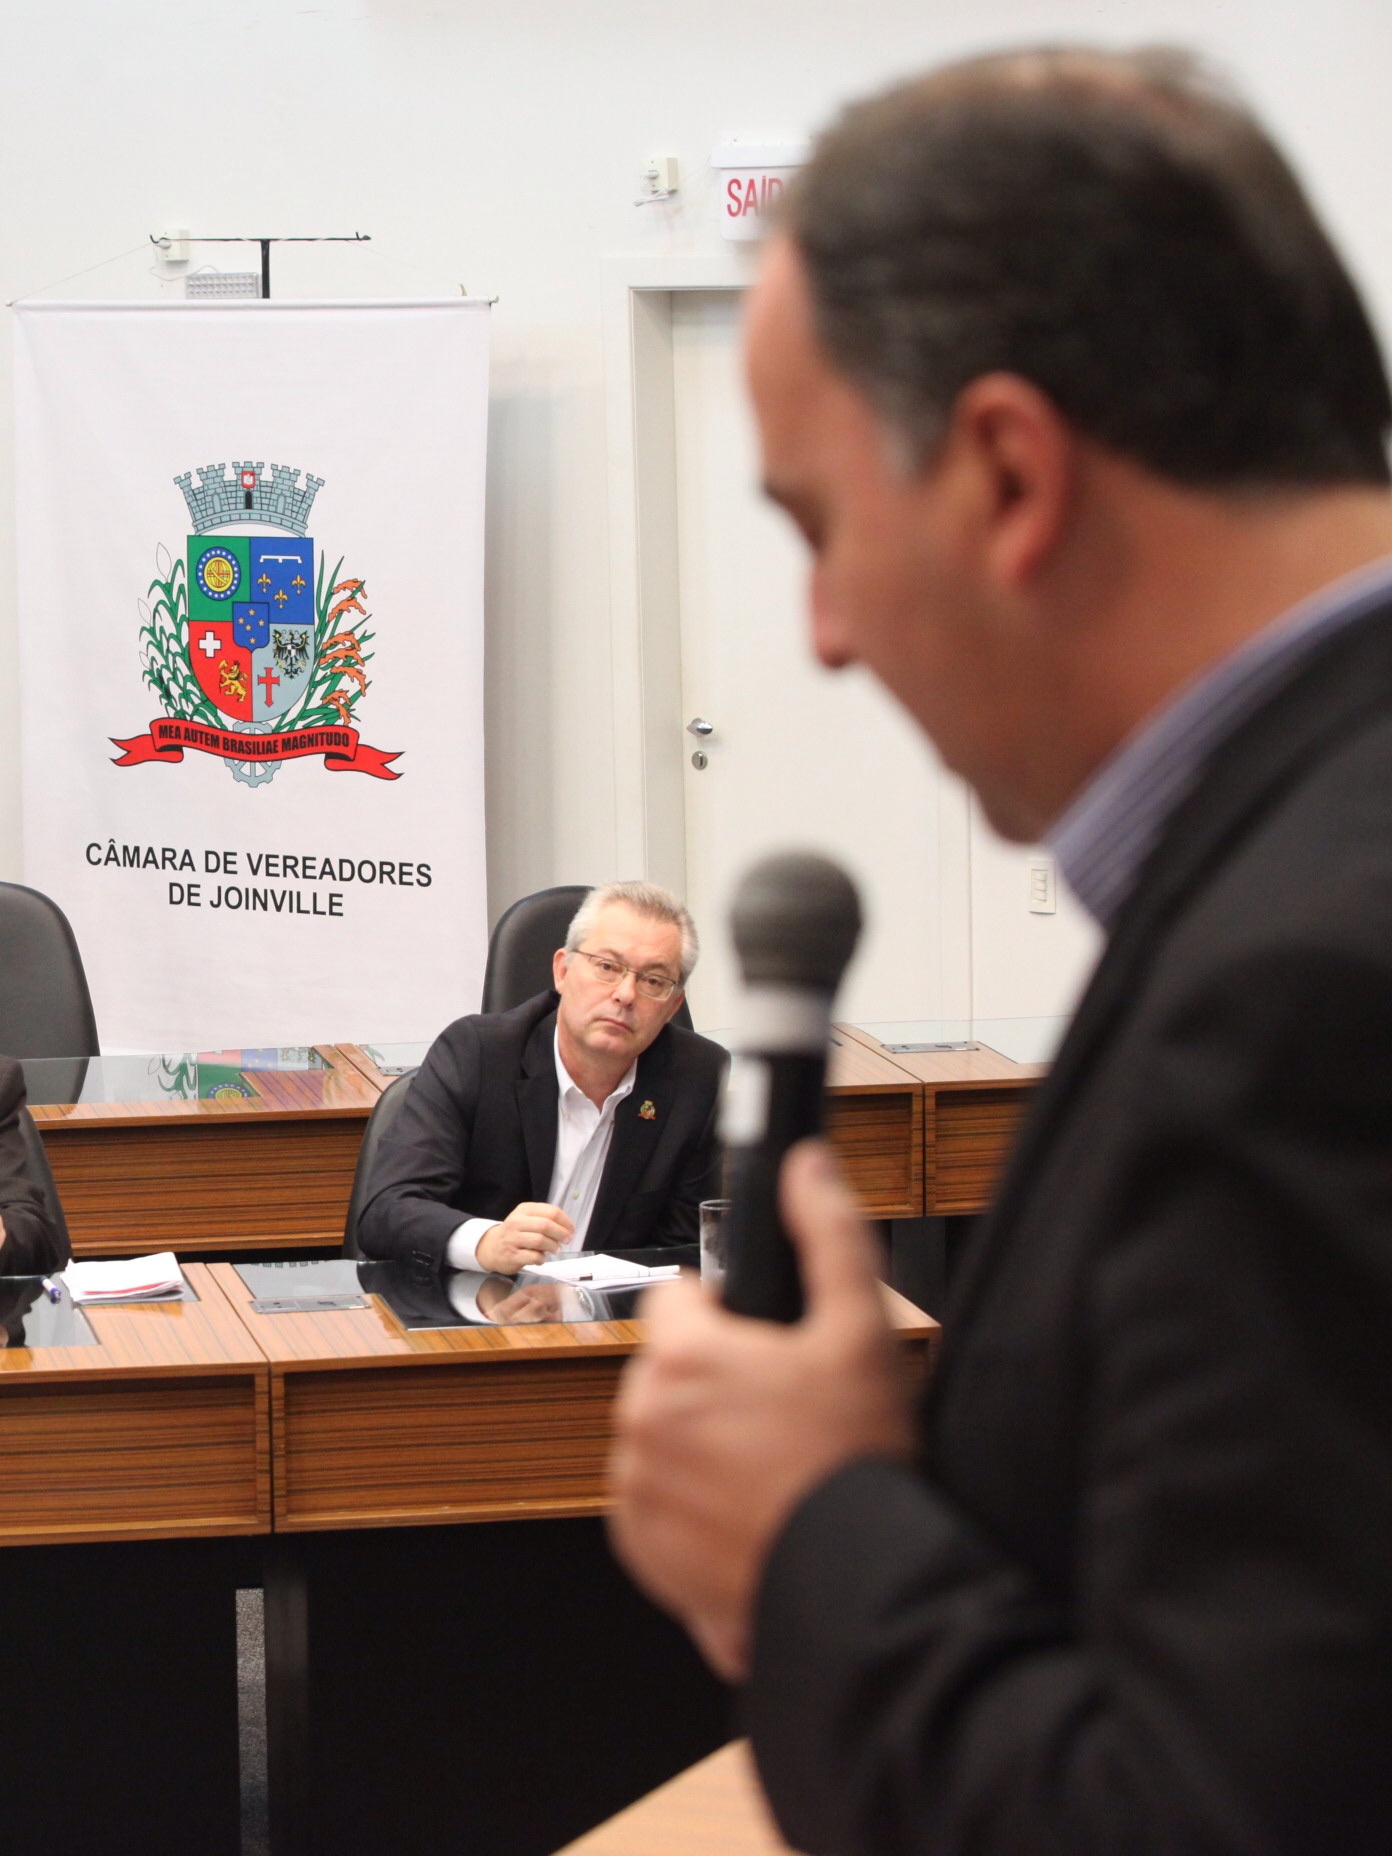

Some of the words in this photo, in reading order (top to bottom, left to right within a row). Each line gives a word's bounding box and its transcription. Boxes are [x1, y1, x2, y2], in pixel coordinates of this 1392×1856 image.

[726, 175, 785, 217] SAÍD
[158, 724, 182, 739] MEA
[183, 726, 220, 748] AUTEM
[222, 738, 279, 755] BRASILIAE
[281, 731, 350, 752] MAGNITUDO
[85, 838, 197, 872] CÂMARA
[204, 850, 238, 875] DE
[246, 852, 432, 888] VEREADORES
[168, 882, 202, 907] DE
[209, 885, 344, 917] JOINVILLE
